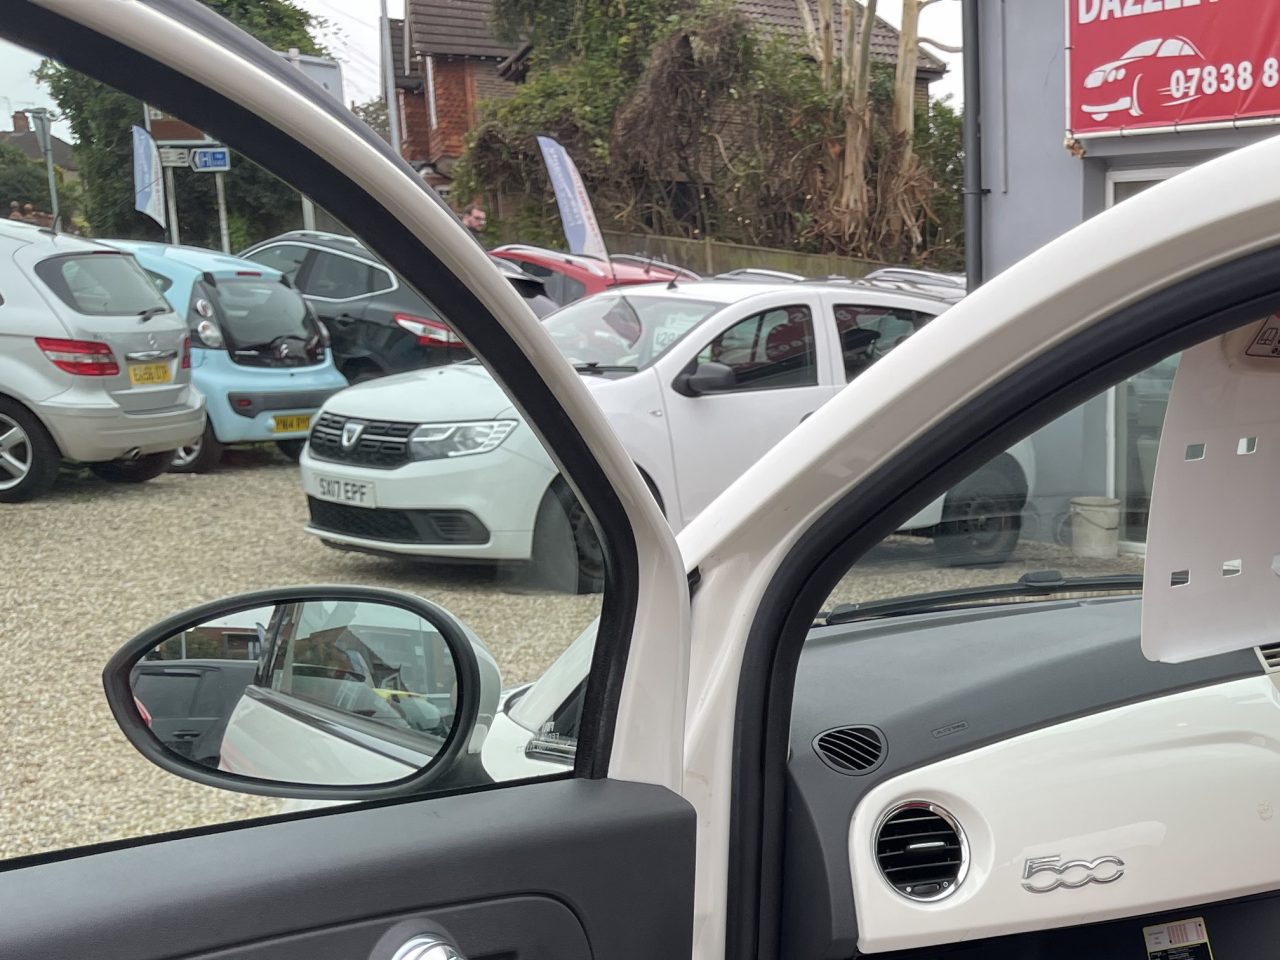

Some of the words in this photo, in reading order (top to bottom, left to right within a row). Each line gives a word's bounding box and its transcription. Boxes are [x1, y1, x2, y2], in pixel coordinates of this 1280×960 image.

[1078, 0, 1201, 24] DAZZ
[1169, 60, 1254, 98] 07838
[344, 481, 366, 502] EPF
[1021, 854, 1126, 894] 500
